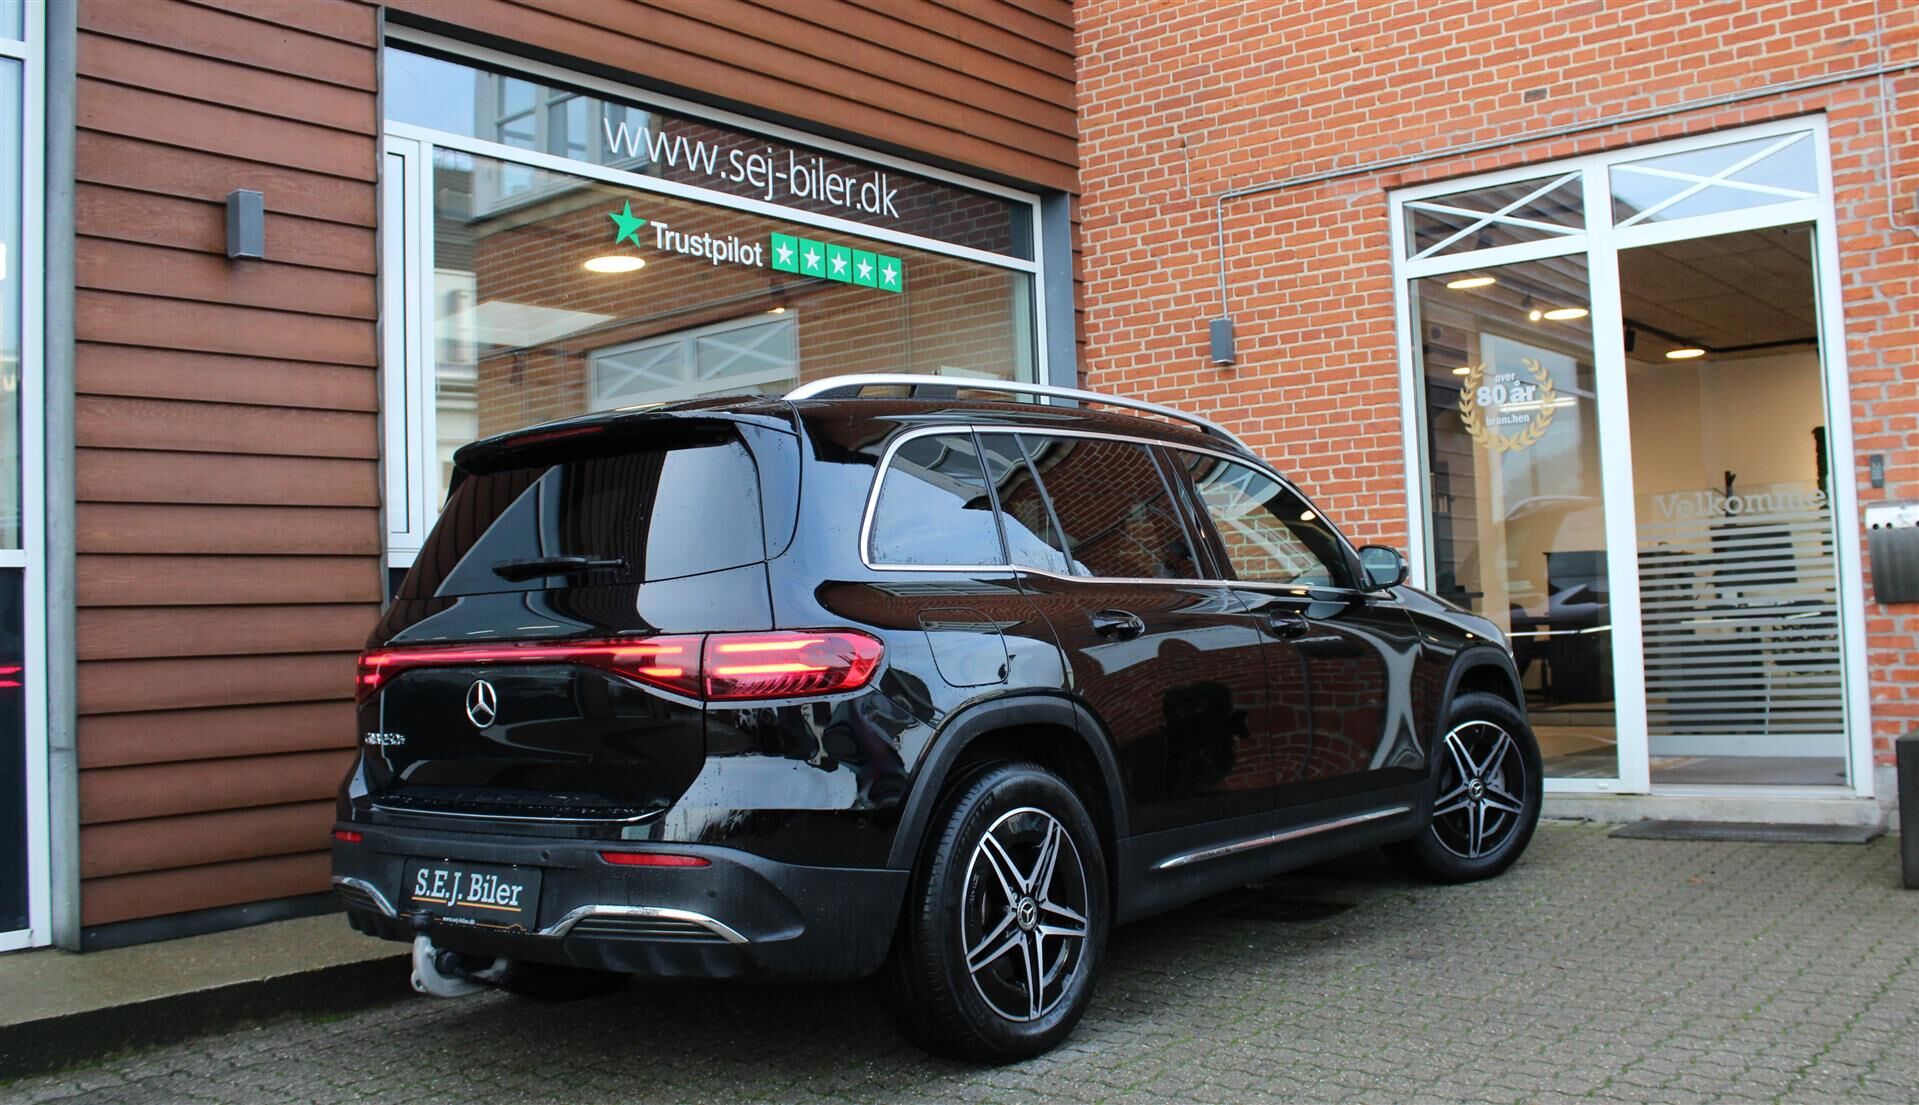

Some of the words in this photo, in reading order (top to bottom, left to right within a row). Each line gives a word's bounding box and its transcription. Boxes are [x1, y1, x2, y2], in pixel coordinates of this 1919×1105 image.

[603, 117, 899, 218] www.sej-biler.dk
[650, 220, 763, 267] Trustpilot
[1476, 384, 1507, 407] 80
[1510, 380, 1536, 403] år
[1495, 372, 1516, 383] over
[1486, 413, 1530, 426] branchen
[414, 868, 463, 907] S.E.J.
[467, 873, 523, 906] Biler
